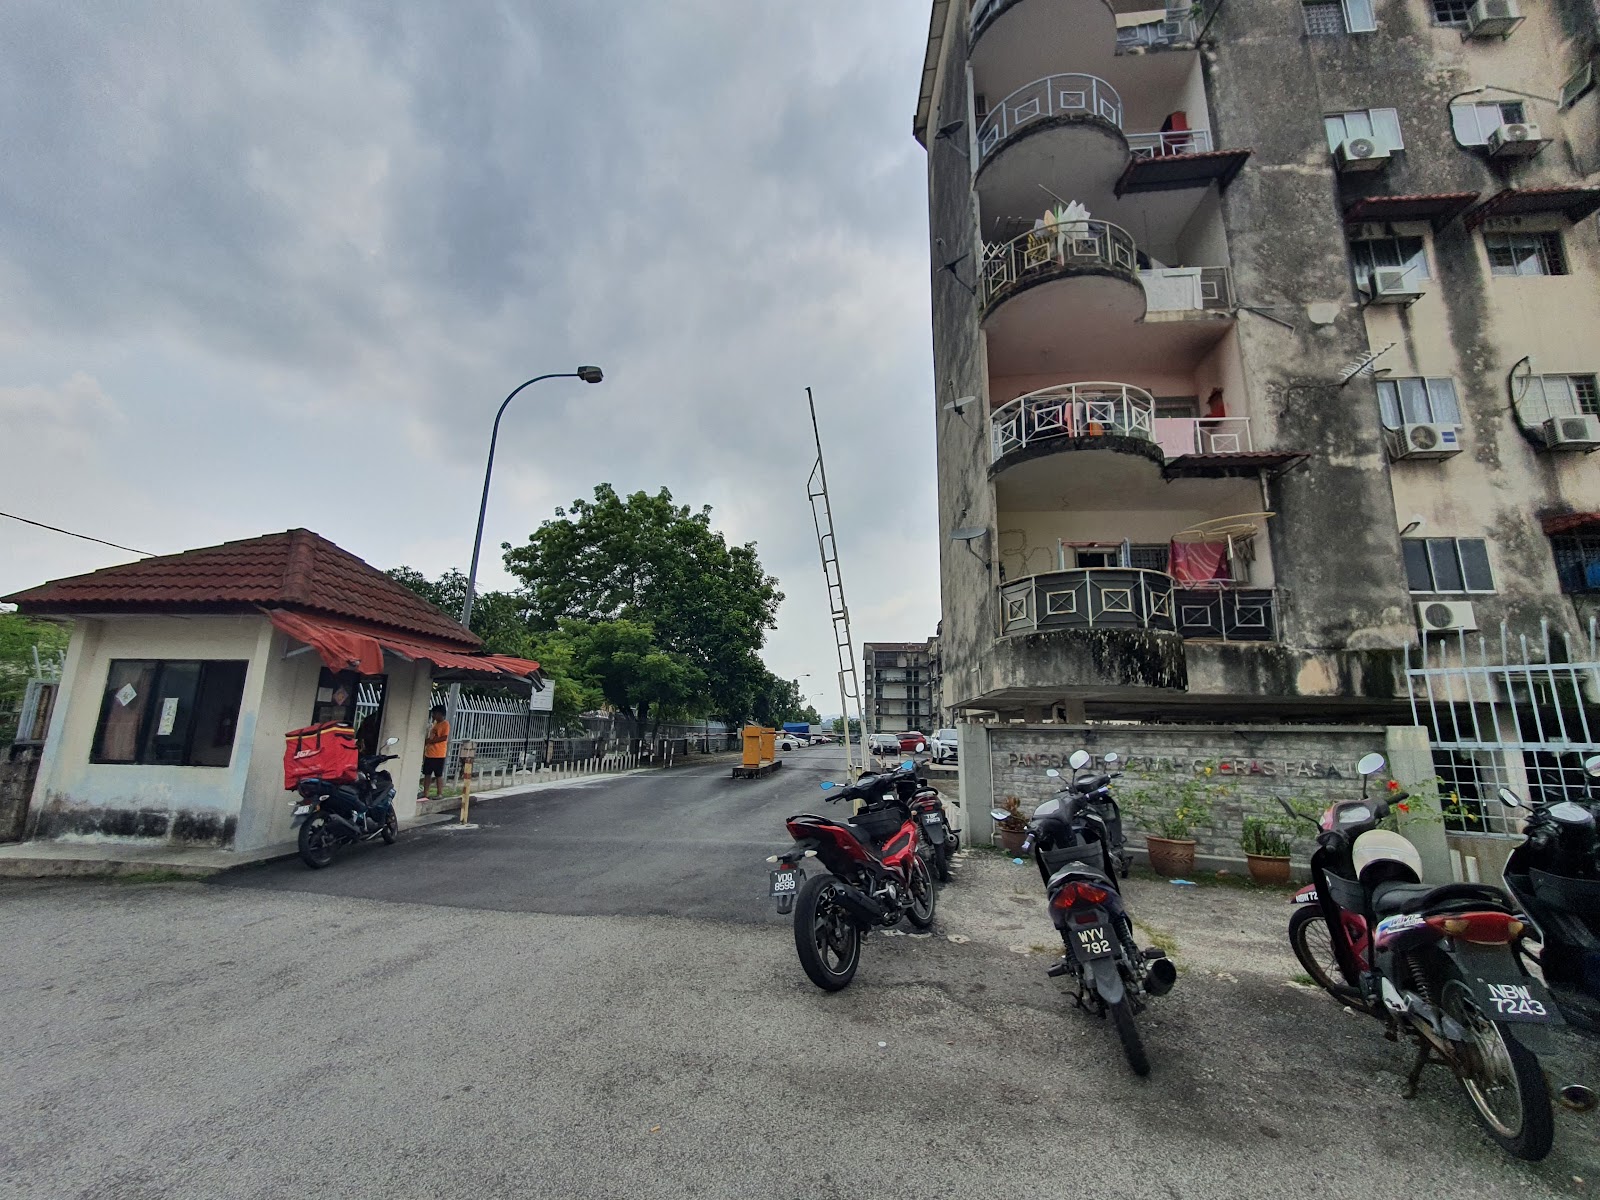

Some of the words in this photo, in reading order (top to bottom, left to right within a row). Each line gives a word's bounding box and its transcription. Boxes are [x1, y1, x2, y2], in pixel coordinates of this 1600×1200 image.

[1284, 760, 1342, 779] FASA
[777, 872, 793, 882] VDQ
[774, 880, 796, 891] 8599
[1078, 927, 1104, 943] WYV
[1082, 940, 1112, 954] 792
[1487, 983, 1532, 1000] NBW
[1489, 997, 1547, 1016] 7243
